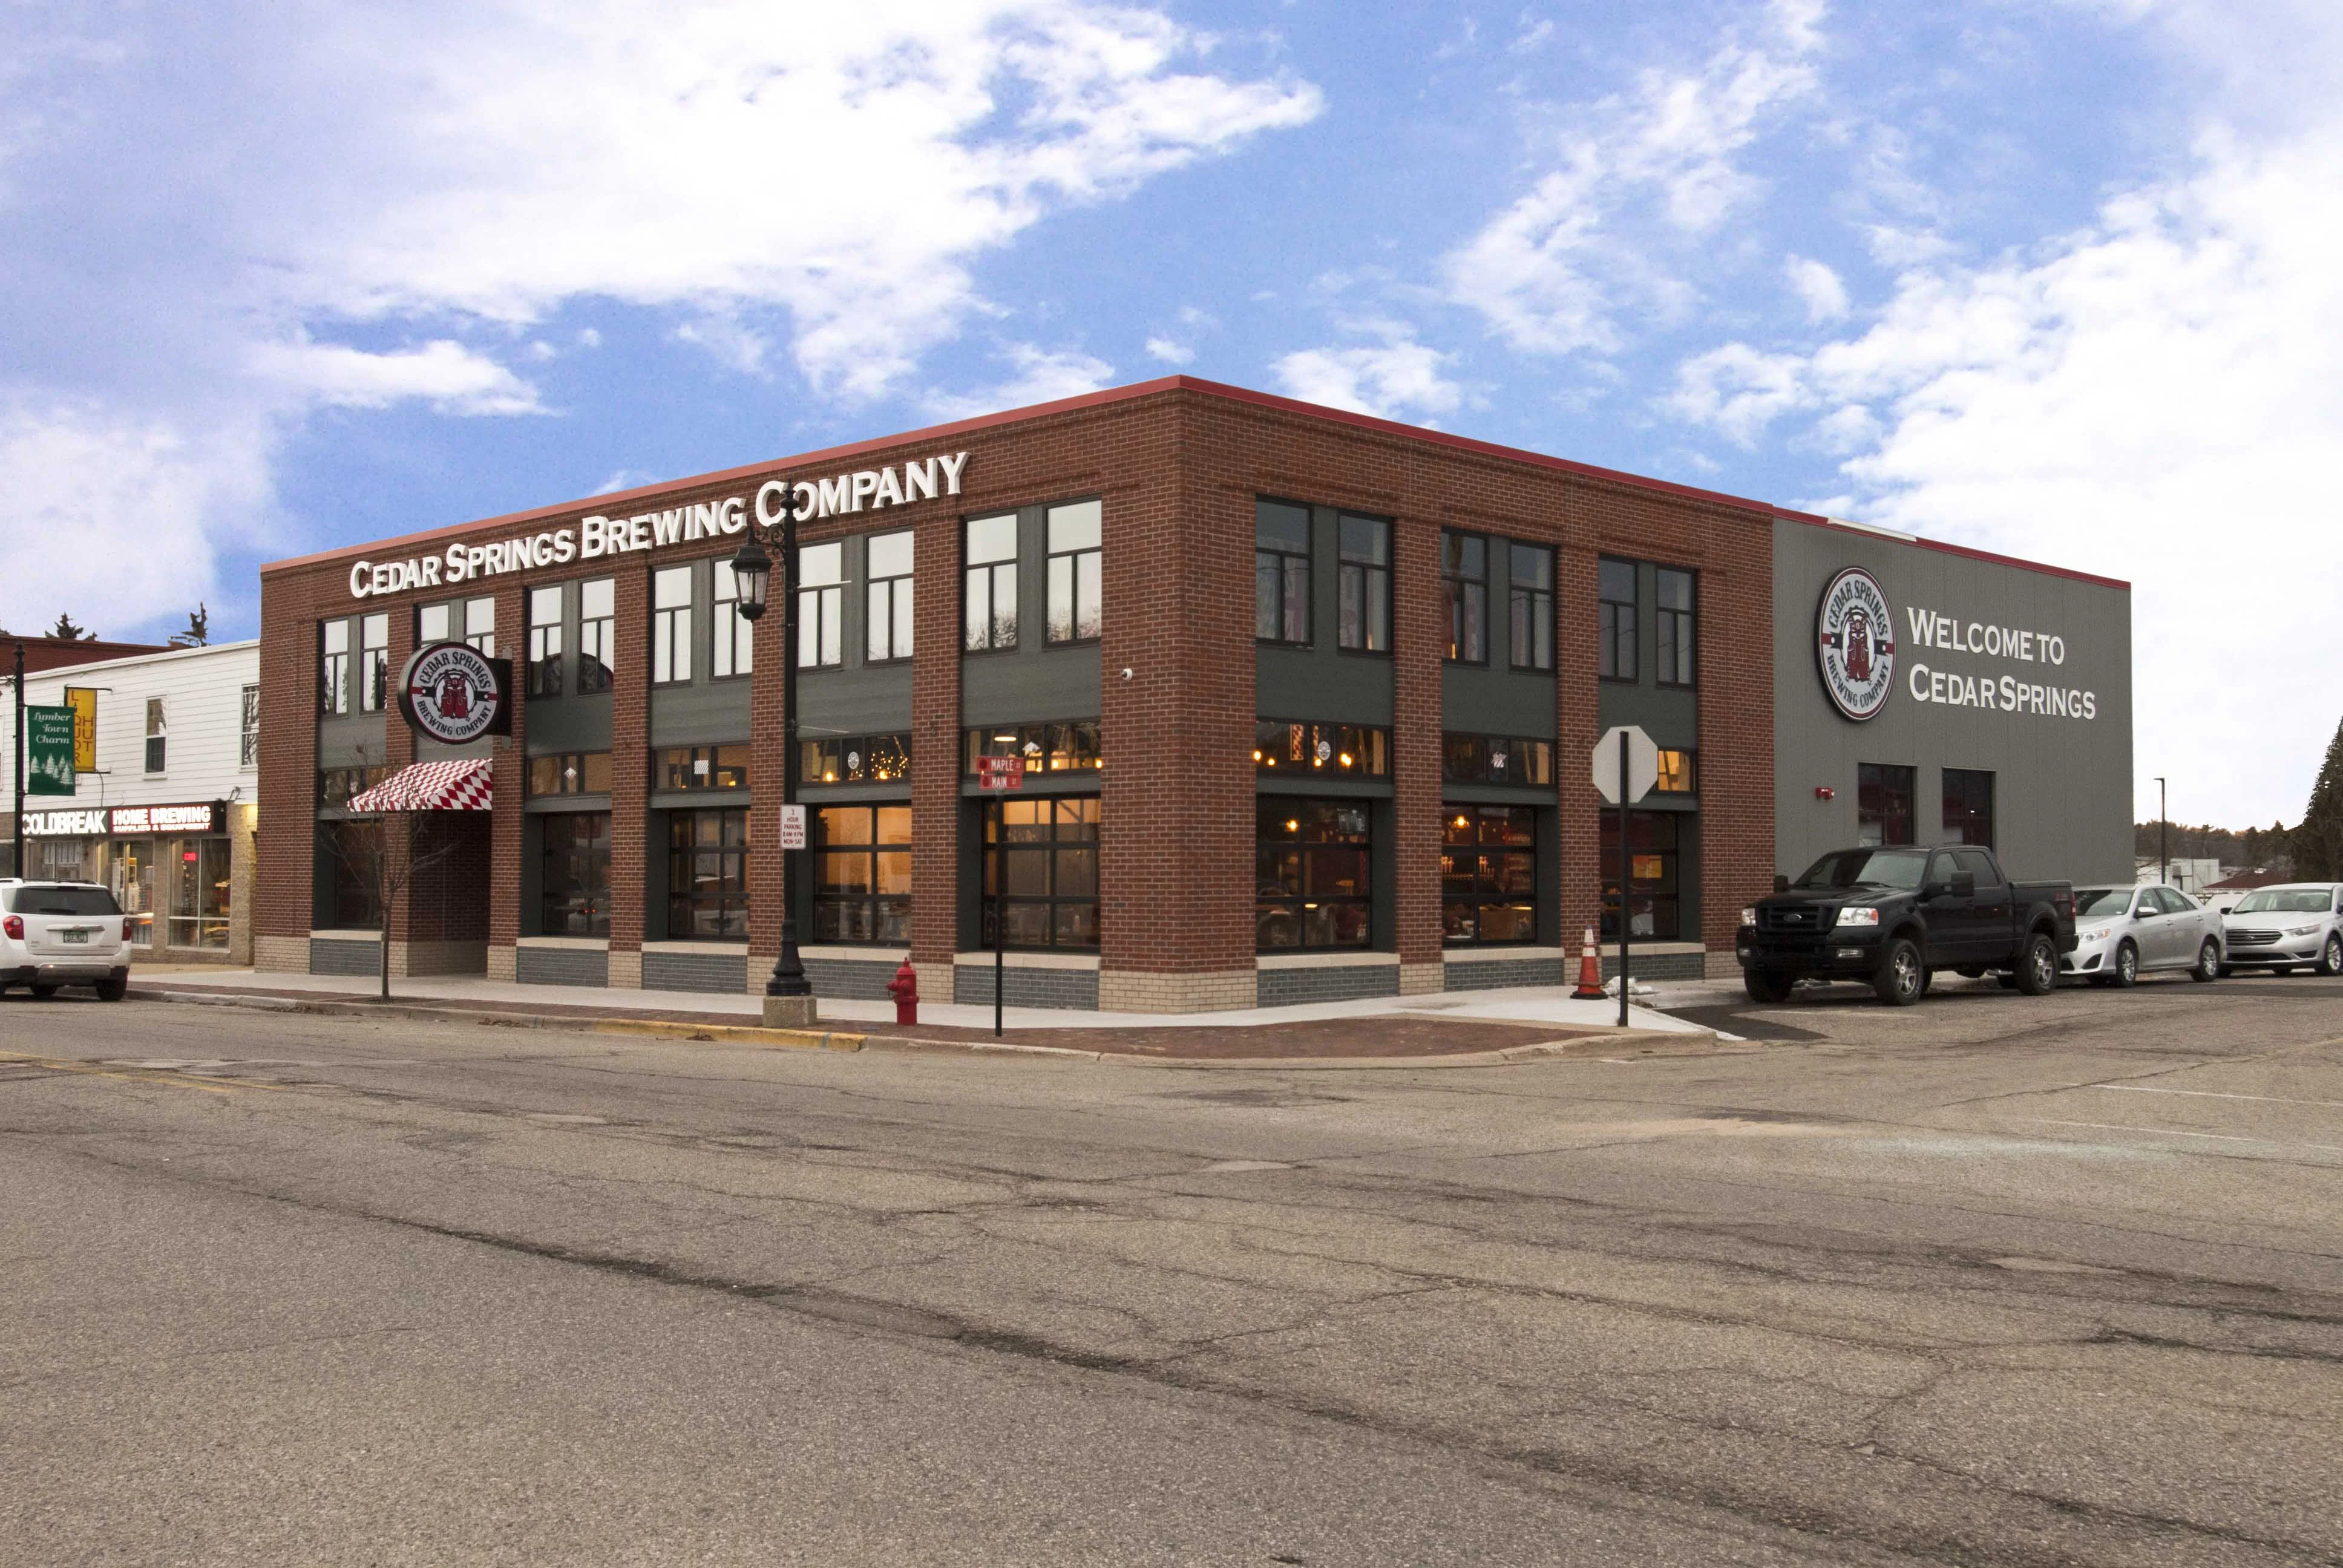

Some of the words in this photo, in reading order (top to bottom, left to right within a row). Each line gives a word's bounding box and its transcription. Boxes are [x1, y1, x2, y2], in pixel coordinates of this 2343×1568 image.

[350, 556, 442, 598] CEDAR
[446, 529, 576, 583] SPRINGS
[581, 497, 747, 559] BREWING
[755, 451, 971, 527] COMPANY
[1828, 581, 1853, 629] CEDAR
[1854, 580, 1888, 637] SPRINGS
[1907, 607, 2034, 661] WELCOME
[2036, 633, 2065, 665] TO
[419, 653, 451, 684] CEDAR
[452, 652, 491, 688] SPRINGS
[1827, 653, 1858, 707] BREWING
[1860, 661, 1889, 708] COMPANY
[1909, 664, 1996, 709] CEDAR
[1999, 676, 2096, 720] SPRINGS
[34, 711, 71, 722] Lumber
[42, 724, 69, 733] Town
[417, 701, 453, 736] BREWING
[456, 705, 491, 736] COMPANY
[36, 734, 70, 744] Charm
[991, 759, 1014, 771] MAPLE
[992, 776, 1007, 789] MAIN
[22, 811, 107, 835] COLDBREAK
[113, 809, 149, 825] HOME
[150, 806, 211, 824] BREWING
